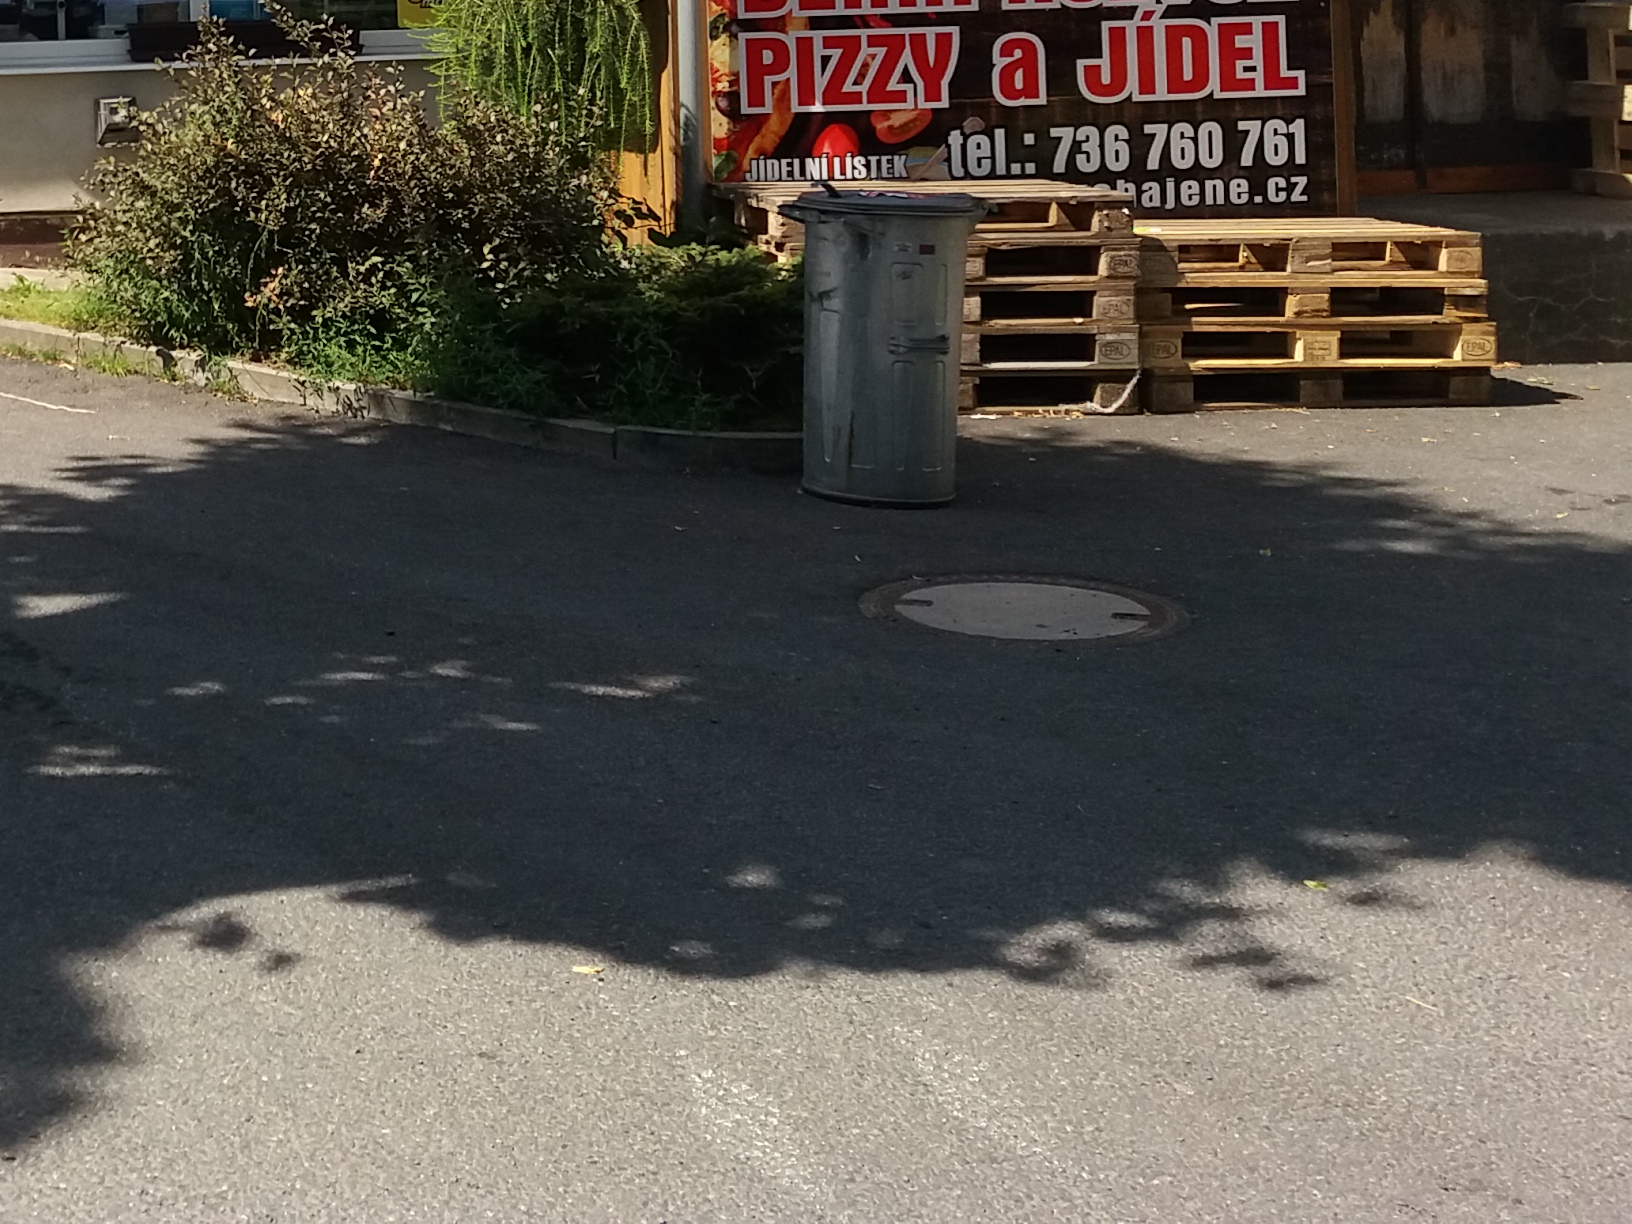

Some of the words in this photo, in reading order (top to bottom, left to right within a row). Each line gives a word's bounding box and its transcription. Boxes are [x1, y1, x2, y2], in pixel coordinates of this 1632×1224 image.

[738, 27, 959, 114] PIZZY
[993, 31, 1045, 105] a
[1076, 6, 1305, 101] JÍDEL
[745, 151, 829, 182] JÍDELNÍ
[833, 152, 908, 180] LÍSTEK
[947, 128, 1036, 176] tel.:
[1050, 125, 1130, 174] 736
[1143, 121, 1224, 171] 760
[1237, 118, 1307, 168] 761
